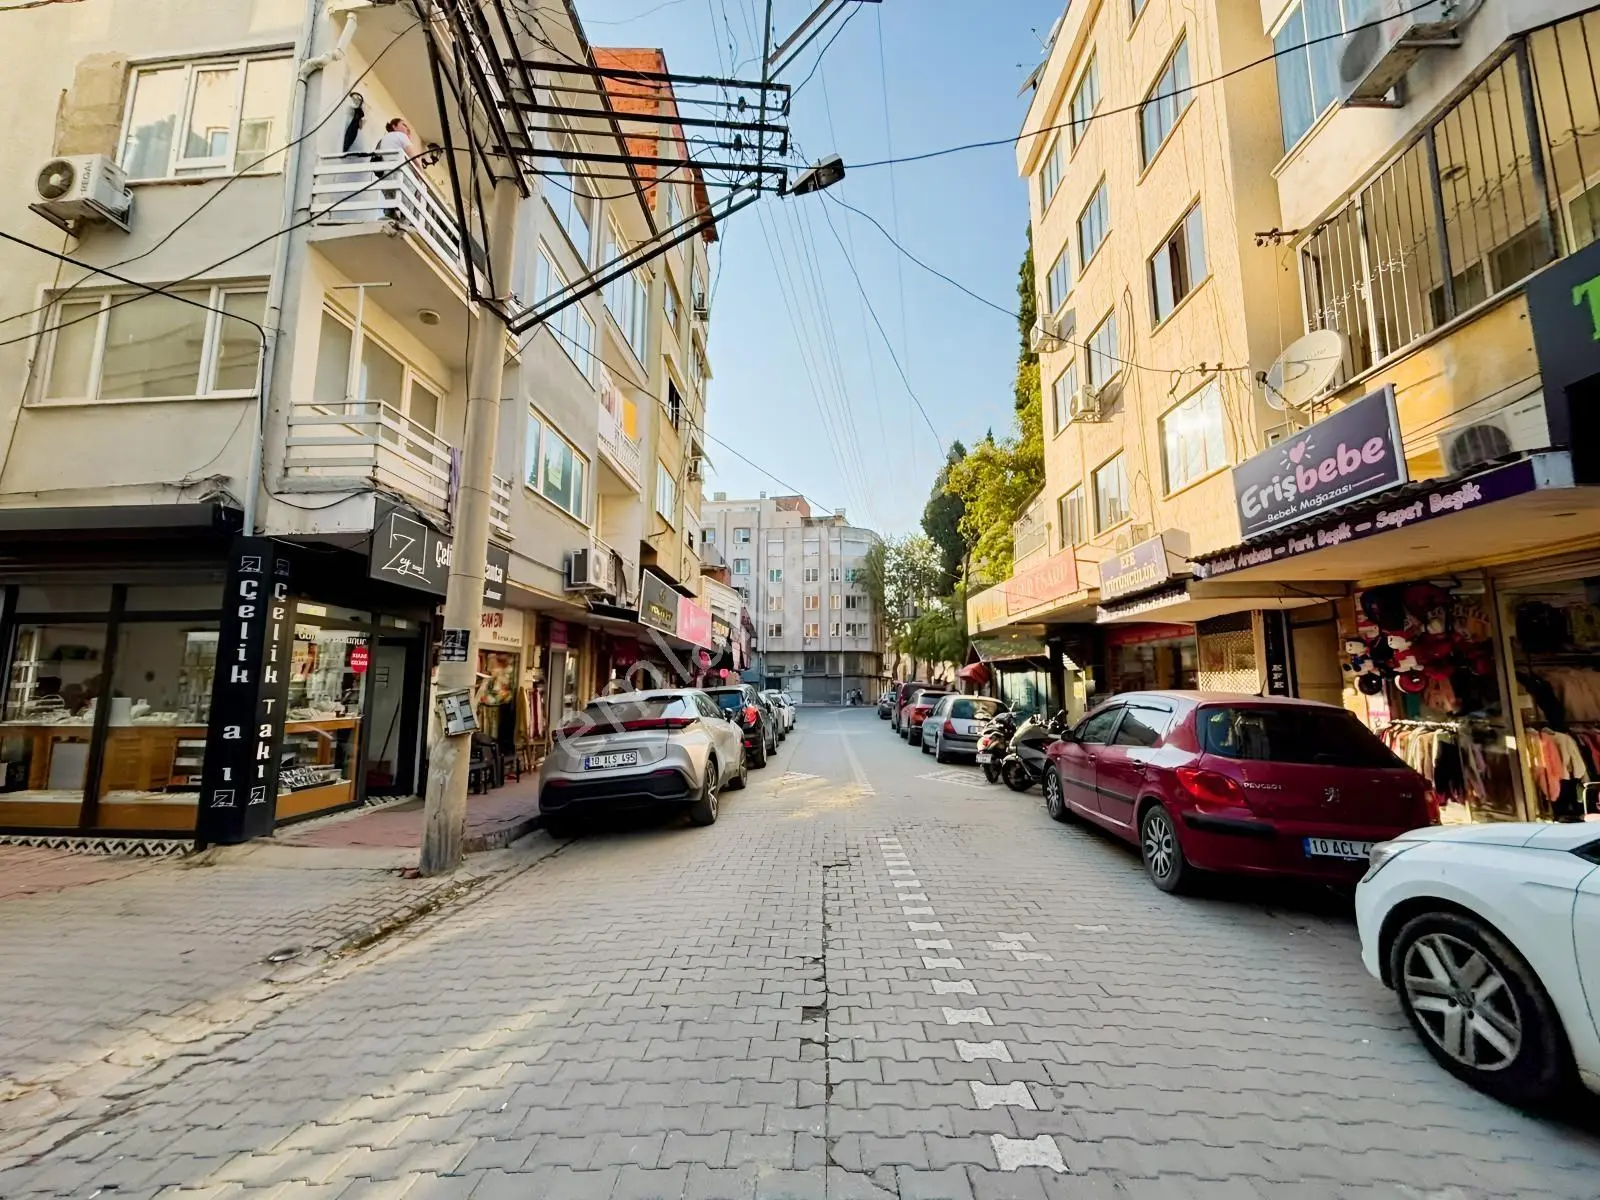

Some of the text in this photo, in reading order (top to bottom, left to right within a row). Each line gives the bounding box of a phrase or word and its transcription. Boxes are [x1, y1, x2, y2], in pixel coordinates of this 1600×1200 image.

[1241, 437, 1385, 518] Erişbebe
[1267, 484, 1352, 523] Bebek Mağazası
[1376, 500, 1424, 528] Sepet
[435, 541, 453, 568] Çeli
[1312, 839, 1329, 854] 10
[1332, 841, 1359, 857] ACL
